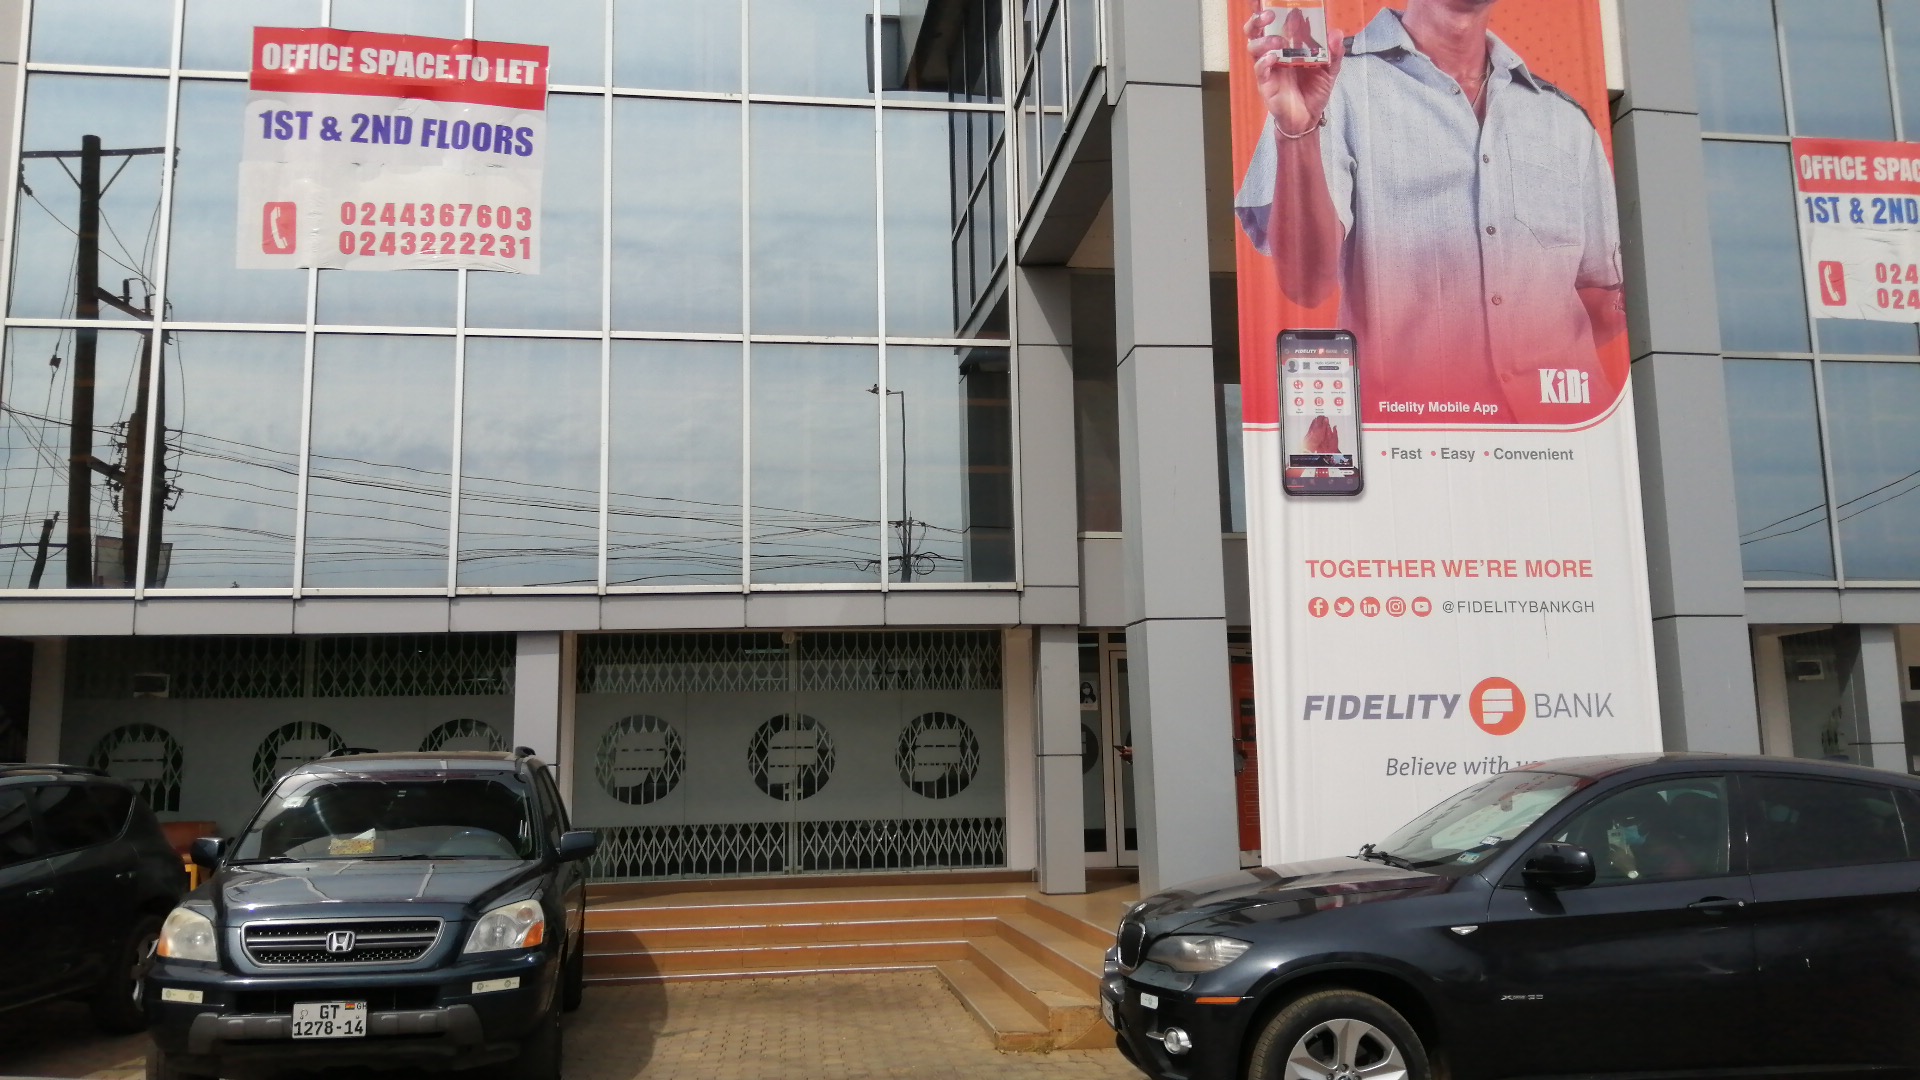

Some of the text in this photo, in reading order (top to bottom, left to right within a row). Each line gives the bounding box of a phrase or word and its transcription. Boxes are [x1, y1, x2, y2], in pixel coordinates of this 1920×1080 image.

[262, 42, 540, 84] OFFICE SPACE TO LET
[259, 110, 534, 157] 1ST & 2ND FLOORS
[1800, 154, 1868, 181] OFFICE
[340, 201, 532, 231] 0244367603
[1805, 196, 1919, 225] 1ST & 2ND
[339, 231, 531, 260] 0243222231
[1875, 262, 1919, 285] 024
[1877, 288, 1920, 310] 024
[1378, 401, 1498, 415] Fidelity Mobile App
[1391, 447, 1574, 462] Fast Easy Convenient
[1305, 559, 1593, 578] TOGETHER WE'RE MORE
[1442, 599, 1595, 614] @FIDELITYBANKGH
[1303, 692, 1615, 721] FIDELITY BANK
[1386, 756, 1457, 776] Believe
[1463, 755, 1509, 775] with
[320, 1004, 340, 1020] GT
[293, 1020, 364, 1036] 1278-14
